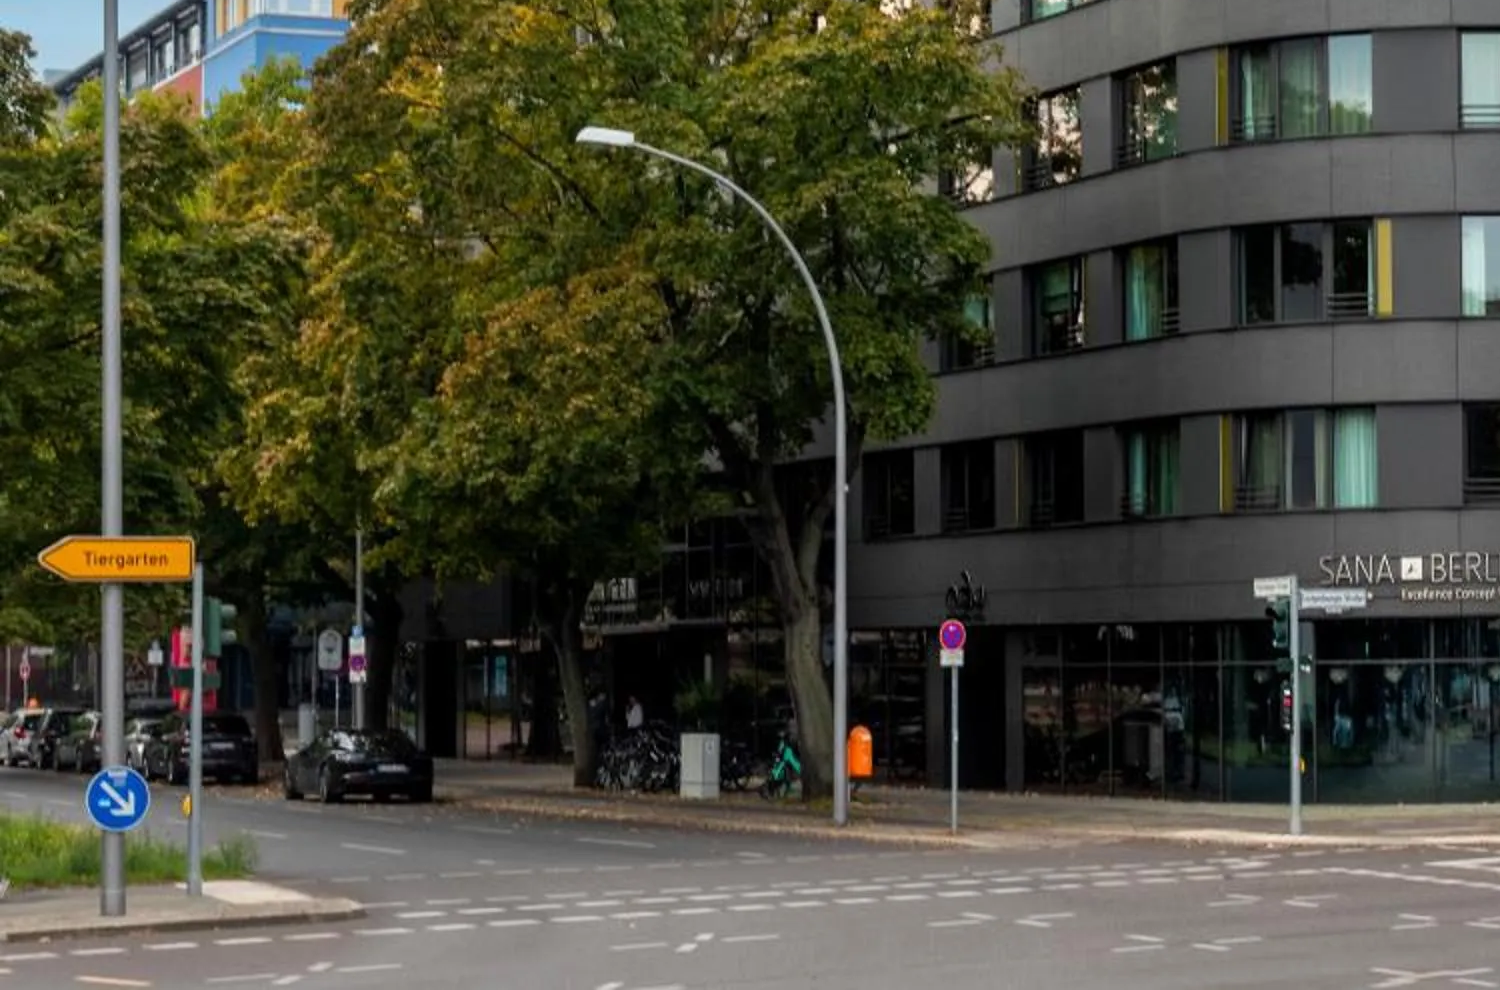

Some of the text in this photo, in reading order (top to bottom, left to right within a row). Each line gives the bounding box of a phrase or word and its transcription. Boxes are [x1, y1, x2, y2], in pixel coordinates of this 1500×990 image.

[84, 550, 169, 570] Tiergarten
[1319, 553, 1395, 585] SANA
[1401, 587, 1453, 602] Excellence
[1455, 586, 1495, 602] Concept
